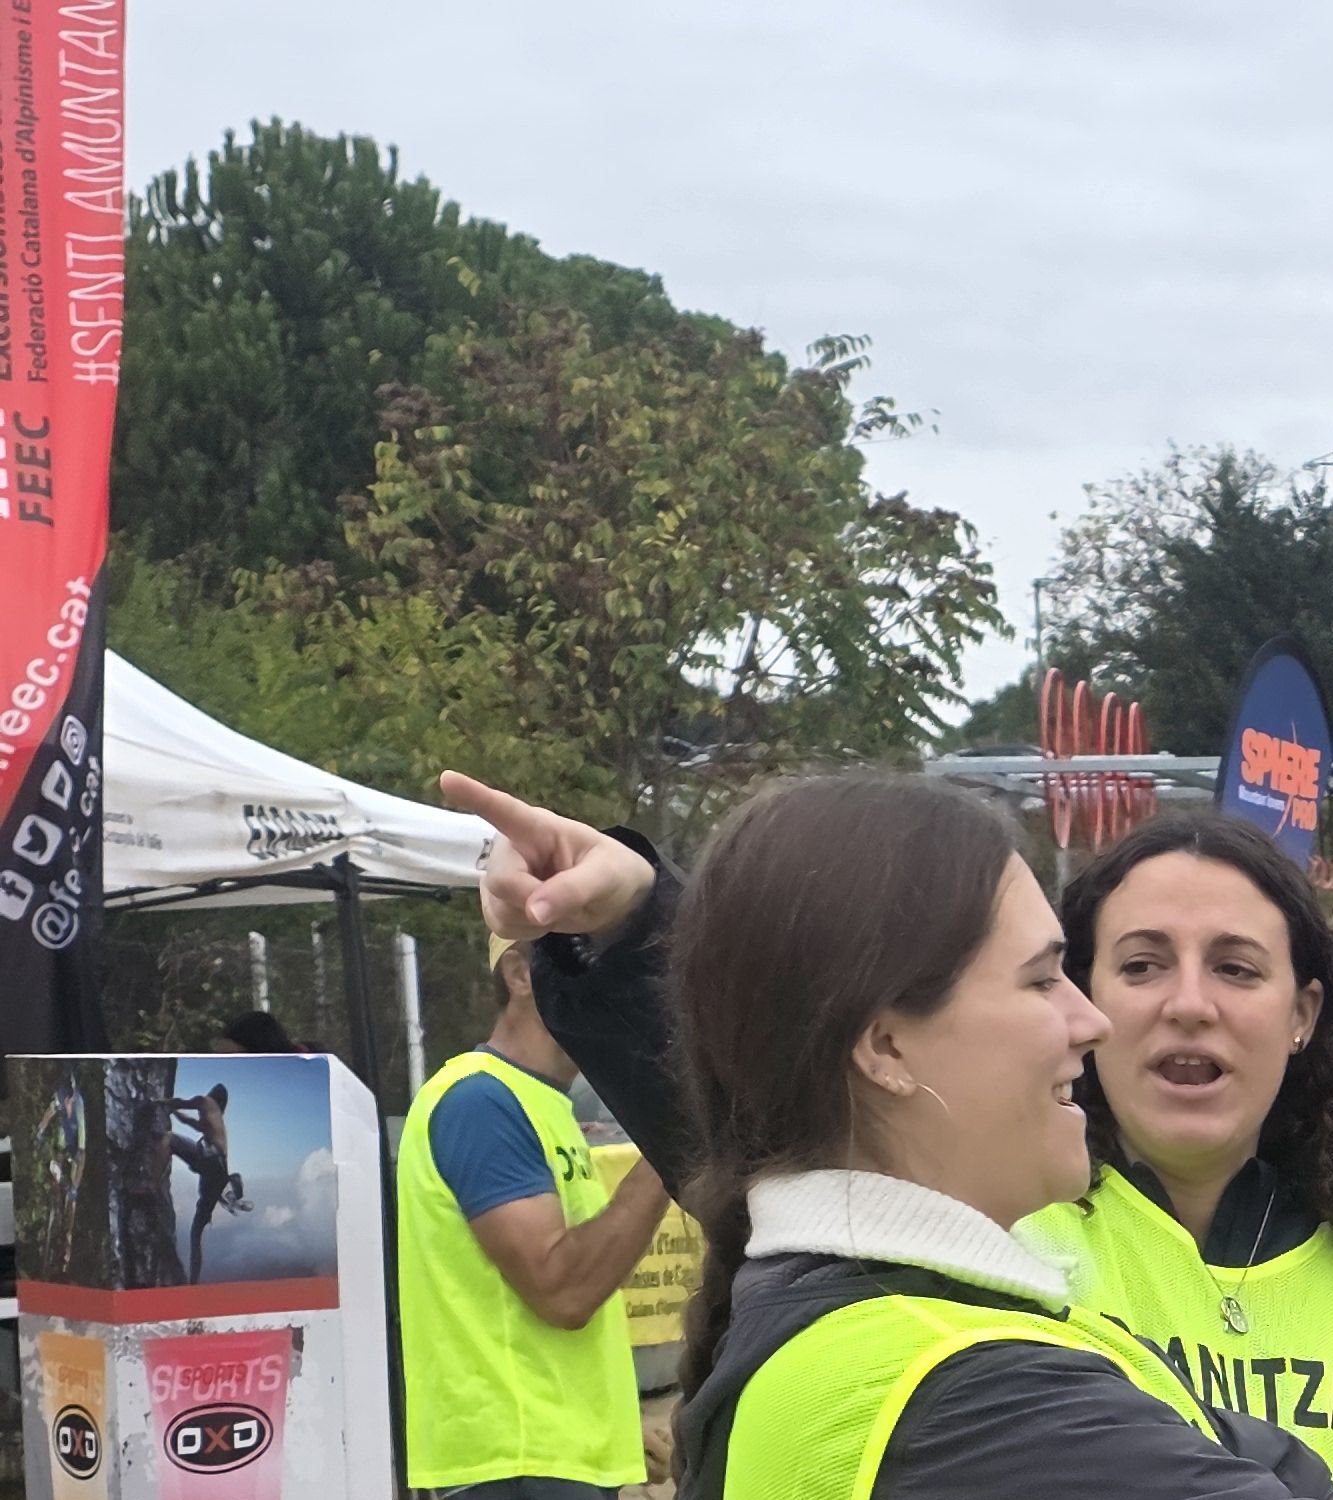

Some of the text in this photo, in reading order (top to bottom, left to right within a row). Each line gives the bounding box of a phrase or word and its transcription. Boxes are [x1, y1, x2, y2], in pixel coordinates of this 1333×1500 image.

[18, 167, 41, 270] Catalana
[22, 273, 48, 384] Federació
[12, 410, 55, 528] FEEC
[177, 1419, 259, 1456] OXD
